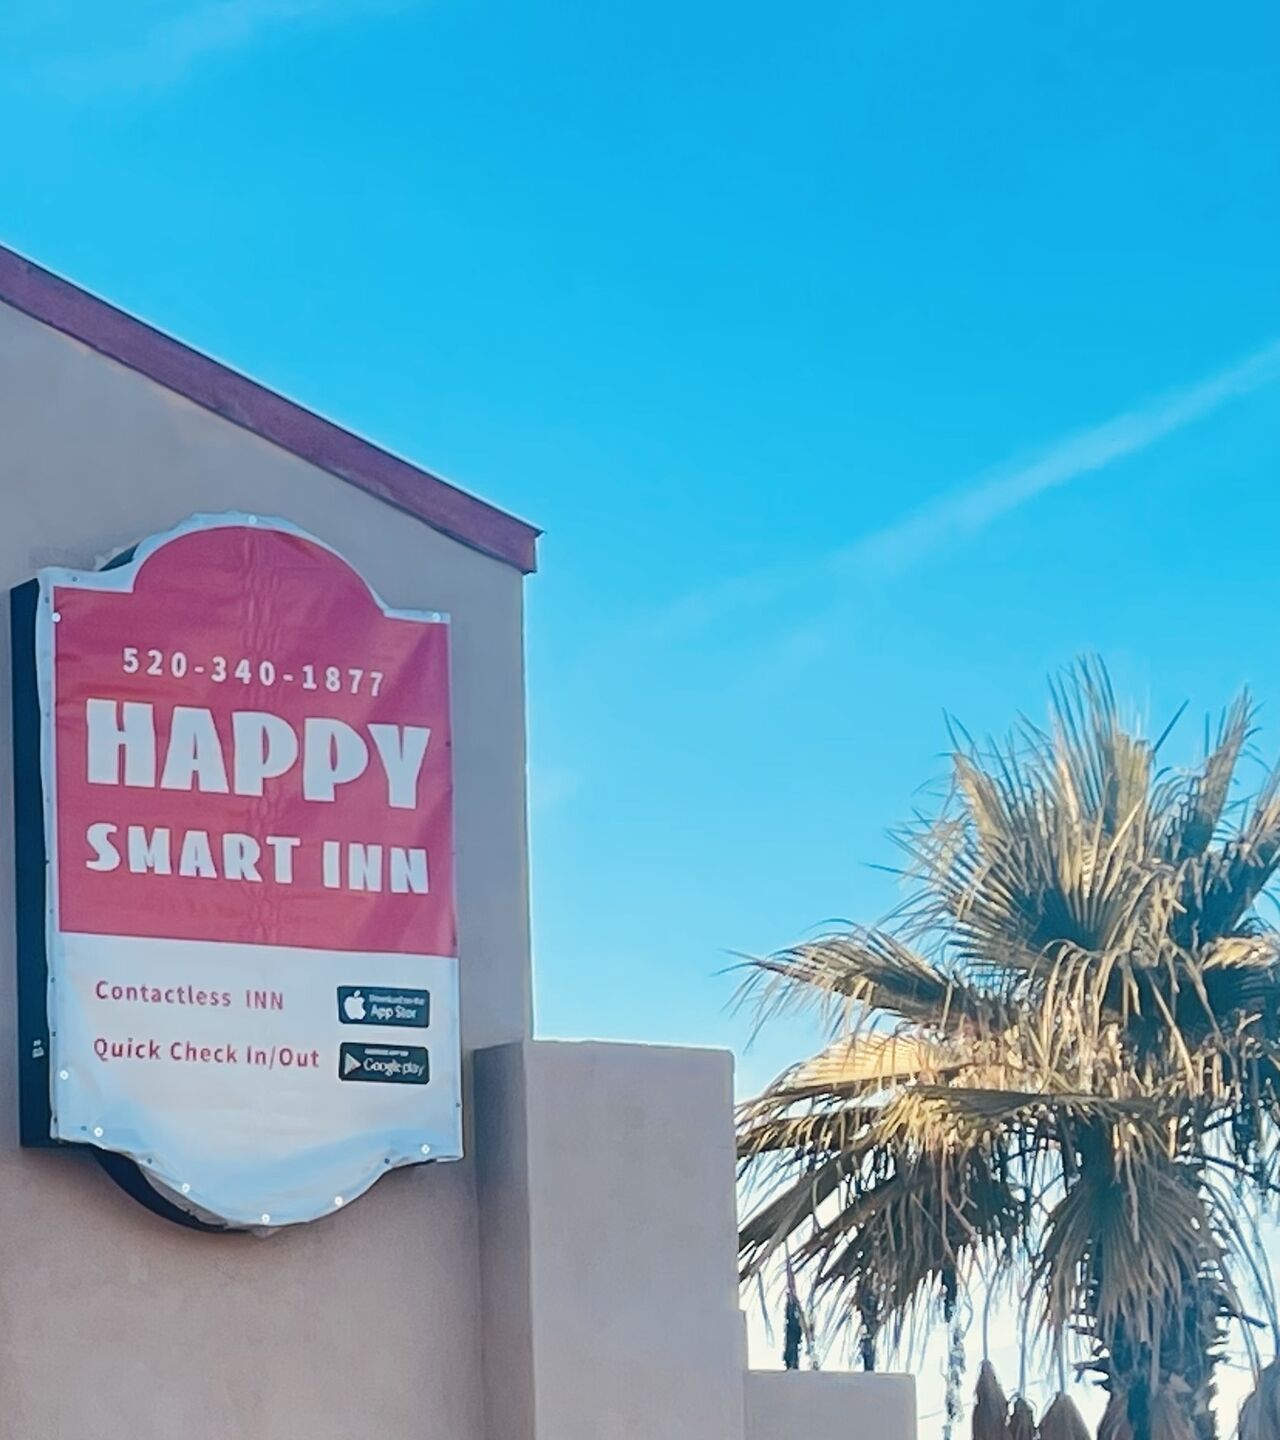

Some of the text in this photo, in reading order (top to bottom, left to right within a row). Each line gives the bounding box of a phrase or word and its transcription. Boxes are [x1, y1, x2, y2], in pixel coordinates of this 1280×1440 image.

[122, 647, 384, 697] 520-340-1877
[86, 698, 431, 809] HAPPY
[86, 822, 429, 893] SMART INN
[95, 980, 284, 1010] Contactless INN
[370, 1004, 394, 1020] App
[93, 1037, 321, 1071] Quick Check In/Out
